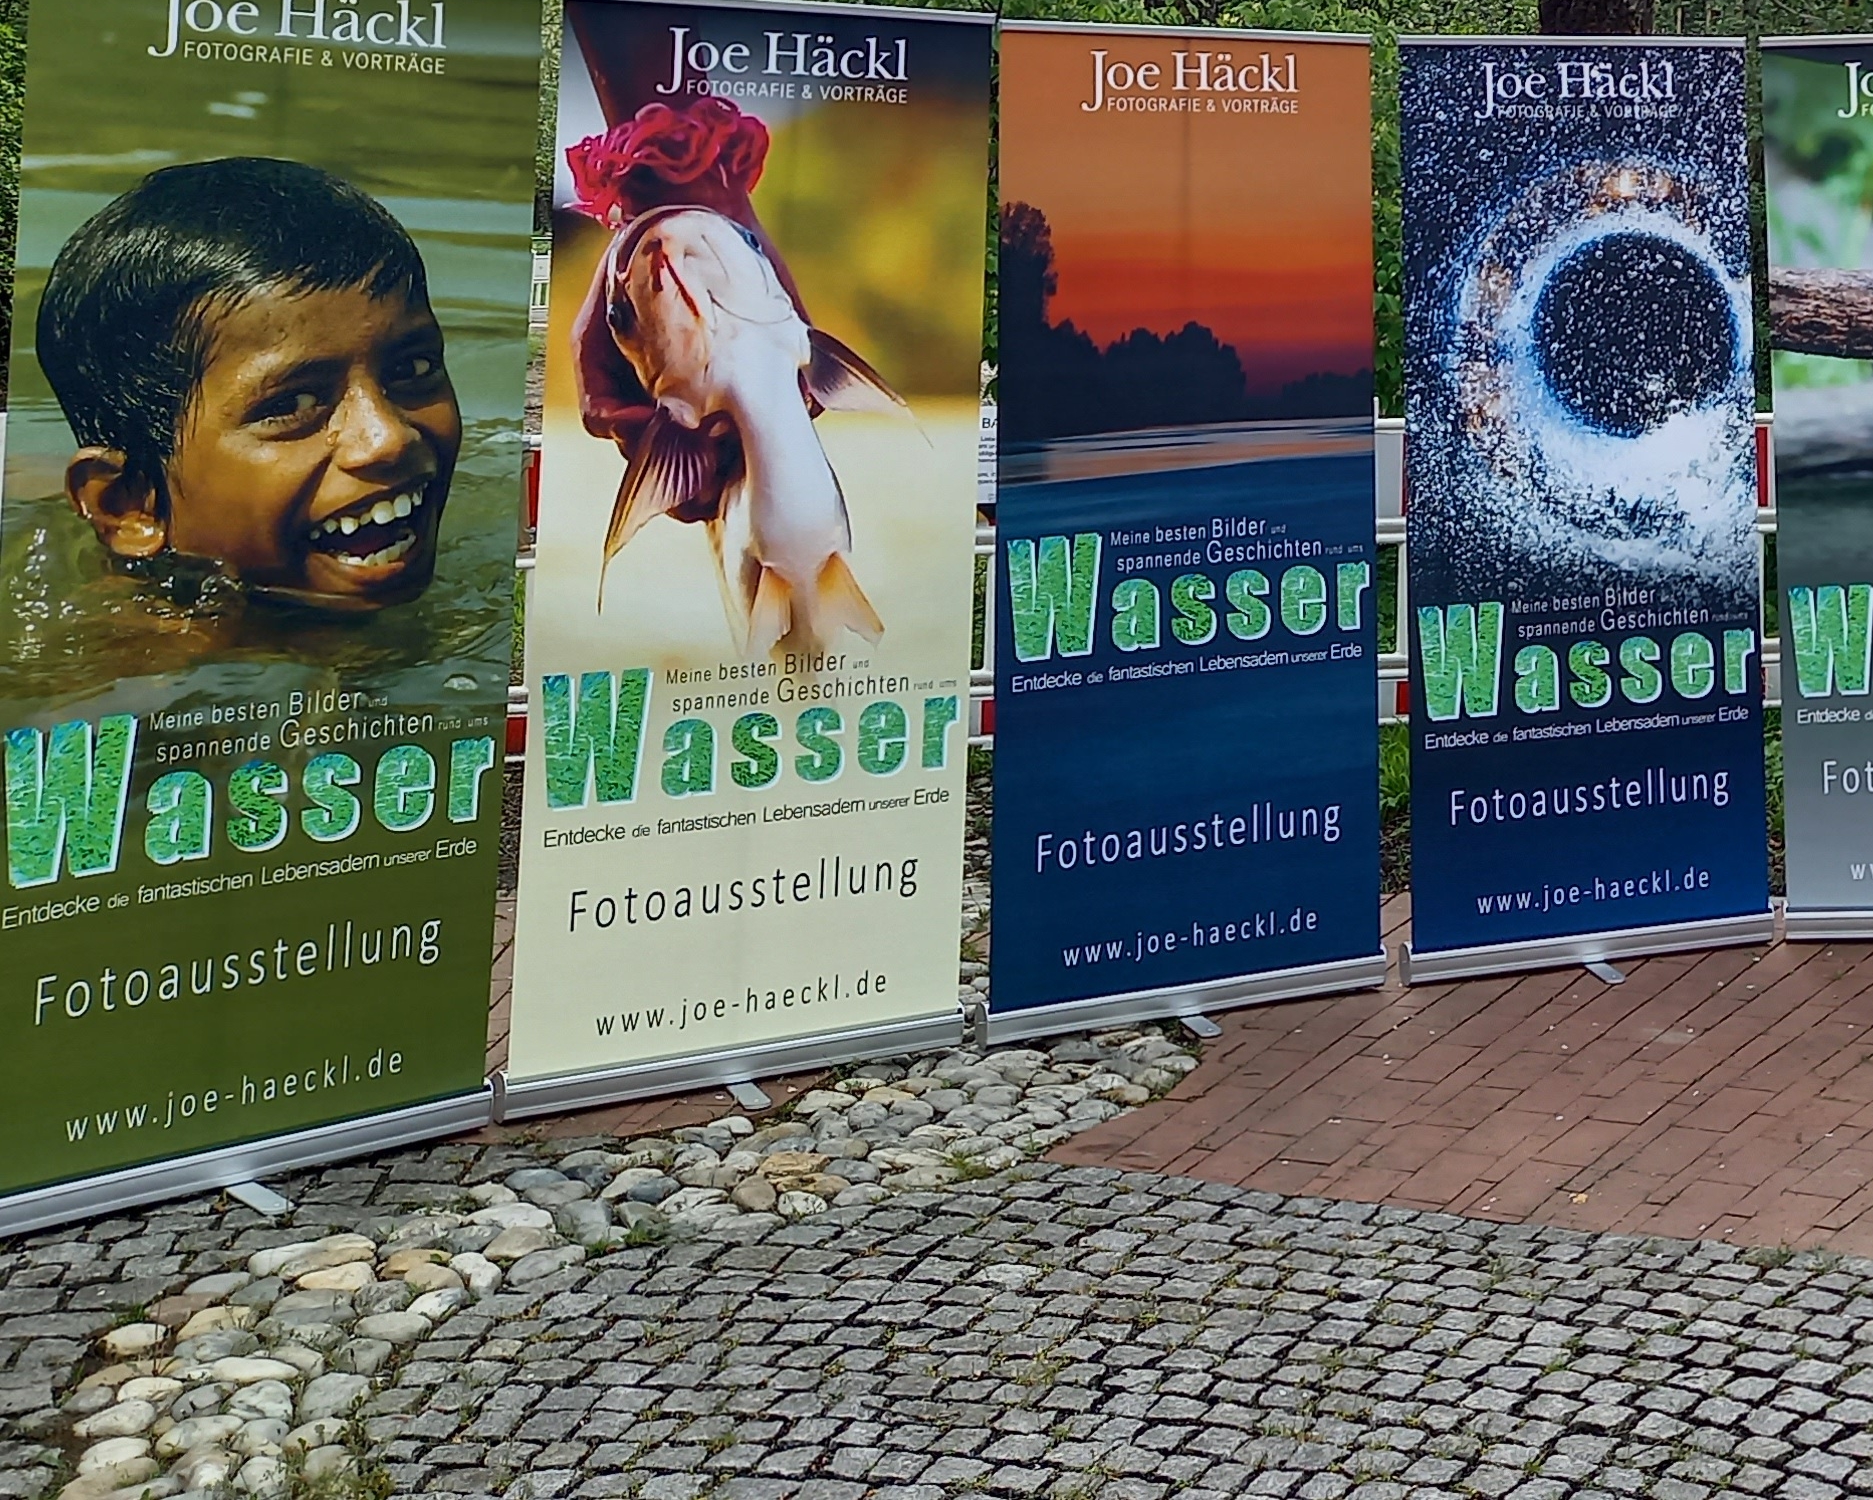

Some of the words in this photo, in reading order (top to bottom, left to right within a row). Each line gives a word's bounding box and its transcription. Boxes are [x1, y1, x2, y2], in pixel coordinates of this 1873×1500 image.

[184, 42, 313, 65] FOTOGRAFIE
[321, 51, 333, 67] &
[342, 51, 446, 74] VORTRÄGE
[656, 27, 750, 94] Joe
[762, 31, 908, 81] Häckl
[1081, 50, 1161, 112] Joe
[1171, 51, 1299, 93] Häckl
[686, 80, 795, 98] FOTOGRAFIE
[802, 85, 812, 99] &
[820, 85, 908, 104] VORTRÄGE
[1107, 97, 1201, 112] FOTOGRAFIE
[1207, 99, 1216, 112] &
[1222, 97, 1298, 114] VORTRÄGE
[1474, 62, 1546, 119] Joe
[1110, 530, 1150, 546] Meine
[1155, 523, 1206, 542] besten
[1212, 517, 1266, 537] Bilder
[1117, 551, 1201, 573] spannende
[1206, 539, 1321, 564] Geschichten
[1007, 533, 1371, 663] Wasser
[1512, 600, 1548, 614] Meine
[1553, 595, 1600, 611] besten
[1605, 588, 1656, 607] Bilder
[1518, 619, 1595, 639] spannende
[1600, 608, 1709, 631] Geschichten
[666, 668, 712, 685] Meine
[718, 660, 777, 680] besten
[784, 653, 846, 676] Bilder
[1012, 672, 1082, 692] Entdecke
[1108, 661, 1194, 681] fantastischen
[1200, 652, 1288, 672] Lebensadern
[1331, 643, 1362, 659] Erde
[1417, 601, 1755, 721] Wasser
[149, 711, 203, 731] Meine
[211, 700, 280, 724] besten
[289, 691, 361, 715] Bilder
[672, 688, 769, 715] spannende
[777, 674, 909, 703] Geschichten
[1797, 708, 1860, 724] Entdecke
[156, 729, 271, 763] spannende
[280, 711, 434, 749] Geschichten
[542, 667, 960, 811] Wasser
[1425, 731, 1489, 750] Entdecke
[1513, 723, 1591, 741] fantastischen
[1596, 714, 1680, 734] Lebensadern
[1719, 707, 1748, 722] Erde
[4, 715, 495, 889] Wasser
[543, 825, 625, 848] Entdecke
[657, 810, 756, 835] fantastischen
[763, 798, 866, 824] Lebensadern
[914, 788, 949, 805] Erde
[1451, 768, 1730, 826] Fotoausstellung
[1037, 802, 1341, 873] Fotoausstellung
[1, 894, 100, 930] Entdecke
[137, 871, 266, 904] fantastischen
[261, 853, 379, 887] Lebensadern
[435, 837, 477, 859] Erde
[569, 856, 919, 932] Fotoausstellung
[1477, 866, 1709, 914] www.joe-haeckl.de
[1063, 907, 1318, 967] www.joe-haeckl.de
[34, 918, 442, 1025] Fotoausstellung
[597, 970, 887, 1037] www.joe-haeckl.de
[66, 1048, 403, 1143] www.joe-haeckl.de
